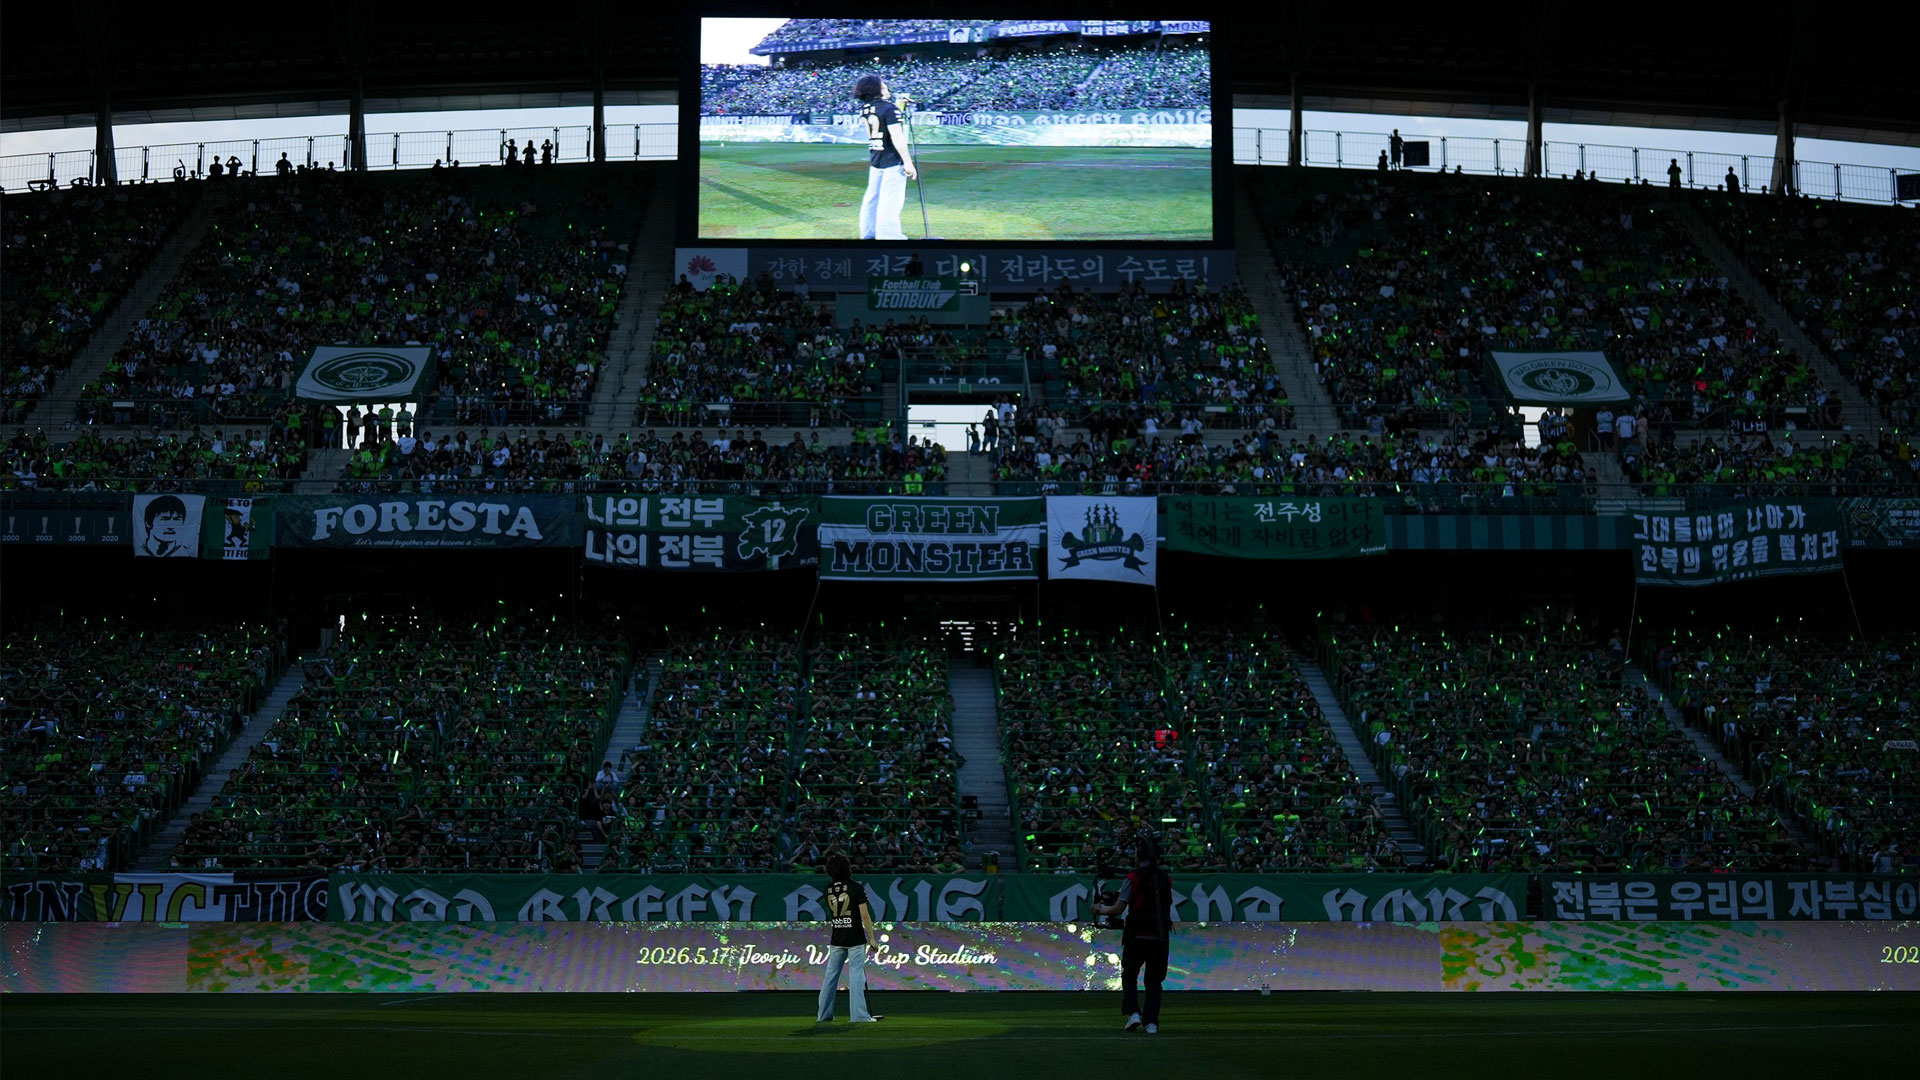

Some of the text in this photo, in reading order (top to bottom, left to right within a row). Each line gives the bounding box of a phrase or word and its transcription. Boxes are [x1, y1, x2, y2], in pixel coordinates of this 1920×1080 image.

[767, 257, 807, 281] 강한
[815, 257, 852, 278] 경제
[1000, 254, 1104, 283] 전라도의
[1117, 255, 1209, 283] 수도로!
[882, 279, 942, 290] Football Club
[311, 500, 544, 540] FORESTA
[586, 496, 725, 528] 나의 전부
[866, 504, 999, 535] GREEN
[1747, 504, 1807, 533] 나아가
[2, 534, 20, 542] 2000
[35, 534, 53, 542] 2003
[101, 534, 119, 542] 2020
[354, 537, 372, 546] Let's
[374, 538, 394, 546] stand
[395, 537, 423, 548] together
[424, 538, 440, 546] and
[440, 538, 465, 546] become
[761, 518, 787, 543] 12
[585, 530, 724, 568] 나의 전북
[831, 540, 1033, 574] MONSTER
[1641, 544, 1701, 574] 전북의
[1711, 535, 1768, 571] 위용을
[827, 891, 851, 918] 92
[1552, 880, 1659, 921] 전북은
[1670, 879, 1775, 921] 우리의
[636, 946, 731, 965] 2026.5.17
[739, 944, 800, 969] Jeonju
[873, 944, 911, 970] Cup
[915, 944, 998, 966] Stadium
